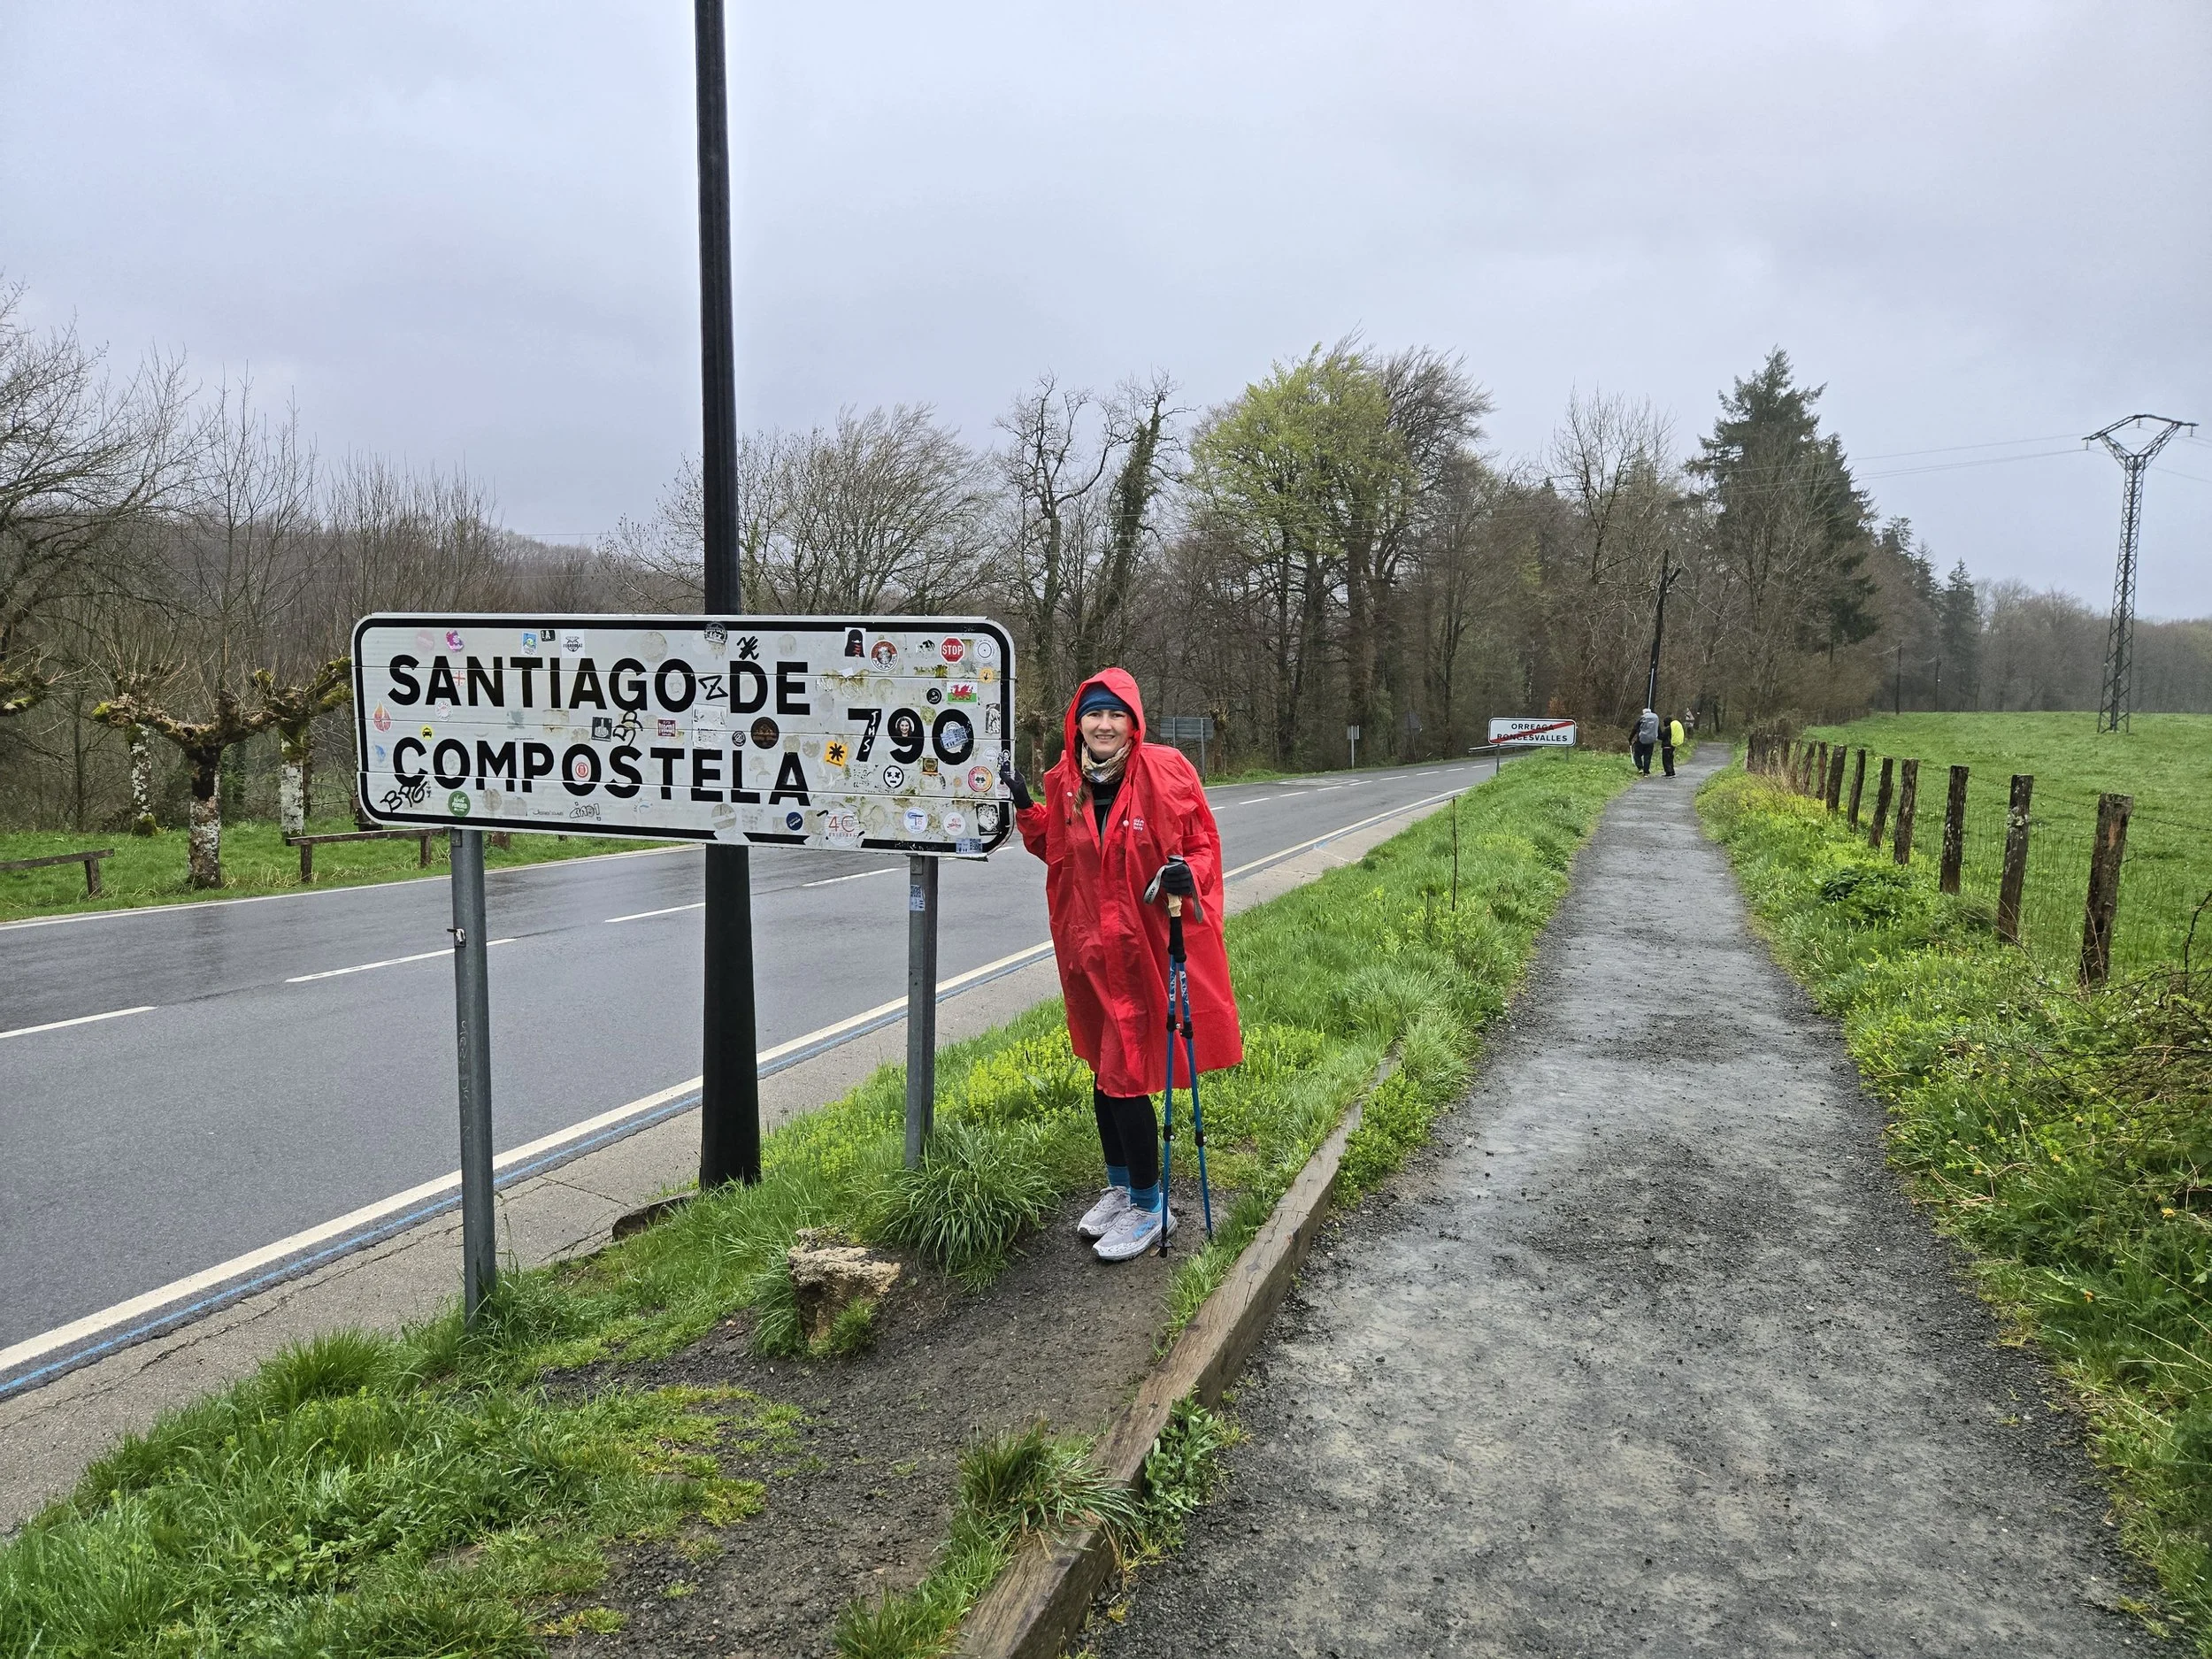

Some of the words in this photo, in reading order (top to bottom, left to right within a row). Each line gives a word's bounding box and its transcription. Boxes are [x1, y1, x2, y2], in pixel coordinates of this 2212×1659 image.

[942, 645, 963, 656] STOP
[388, 654, 695, 713] SANTIAGO
[729, 661, 810, 715] DE
[848, 707, 975, 766] 790
[393, 736, 811, 807] COMPOSTELA
